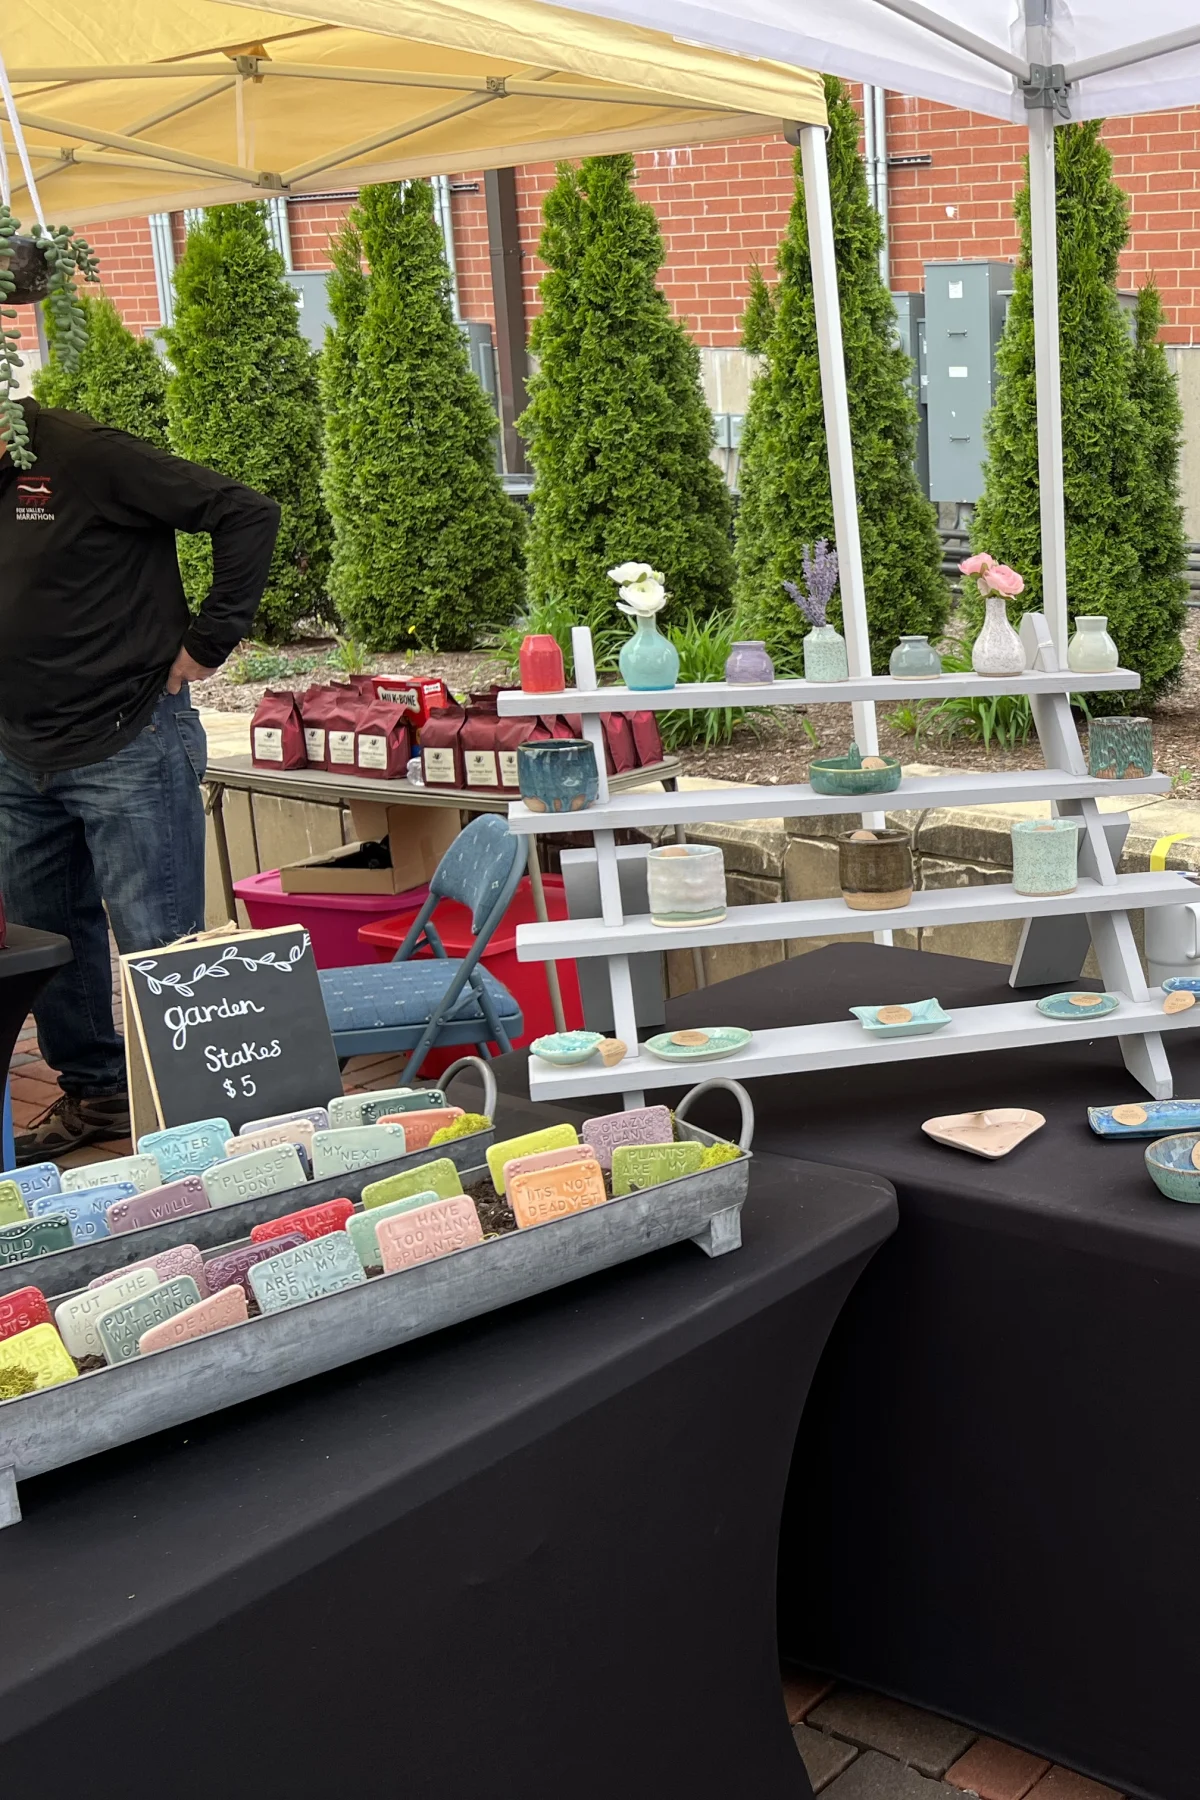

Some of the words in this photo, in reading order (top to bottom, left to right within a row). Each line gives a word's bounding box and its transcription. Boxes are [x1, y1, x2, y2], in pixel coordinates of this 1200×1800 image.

[381, 693, 416, 706] MILK-BONE
[164, 997, 265, 1050] garden
[204, 1039, 282, 1072] Stakes
[601, 1116, 647, 1133] CRAZY
[601, 1127, 647, 1144] PLANT
[160, 1136, 211, 1156] WATER
[177, 1151, 200, 1165] ME
[322, 1145, 342, 1158] MY
[341, 1148, 380, 1162] NEXT
[627, 1148, 686, 1161] PLANTS
[129, 1167, 150, 1182] MY
[222, 1158, 285, 1188] PLEASE
[622, 1163, 650, 1176] ARE
[668, 1161, 687, 1172] MY
[237, 1174, 278, 1196] DONT
[564, 1177, 592, 1192] NOT
[92, 1196, 123, 1214] NO
[151, 1197, 194, 1219] WILL
[416, 1204, 460, 1226] HAVE
[528, 1200, 566, 1217] DEAD
[570, 1192, 600, 1207] YET
[271, 1209, 336, 1234] SERIAL
[393, 1231, 425, 1249] TOO
[431, 1214, 473, 1236] MANY
[0, 1238, 34, 1256] ULD
[269, 1239, 336, 1274] PLANTS
[401, 1233, 465, 1264] PLANTS
[265, 1271, 298, 1294] ARE
[315, 1254, 337, 1273] MY
[69, 1295, 101, 1319] PUT
[115, 1275, 149, 1298] THE
[278, 1276, 321, 1301] SOIL
[103, 1306, 135, 1332] PUT
[150, 1283, 182, 1305] THE
[110, 1294, 195, 1343] WATERING
[174, 1306, 219, 1337] DEAD
[3, 1336, 37, 1360] AVE
[26, 1344, 58, 1369] ANY
